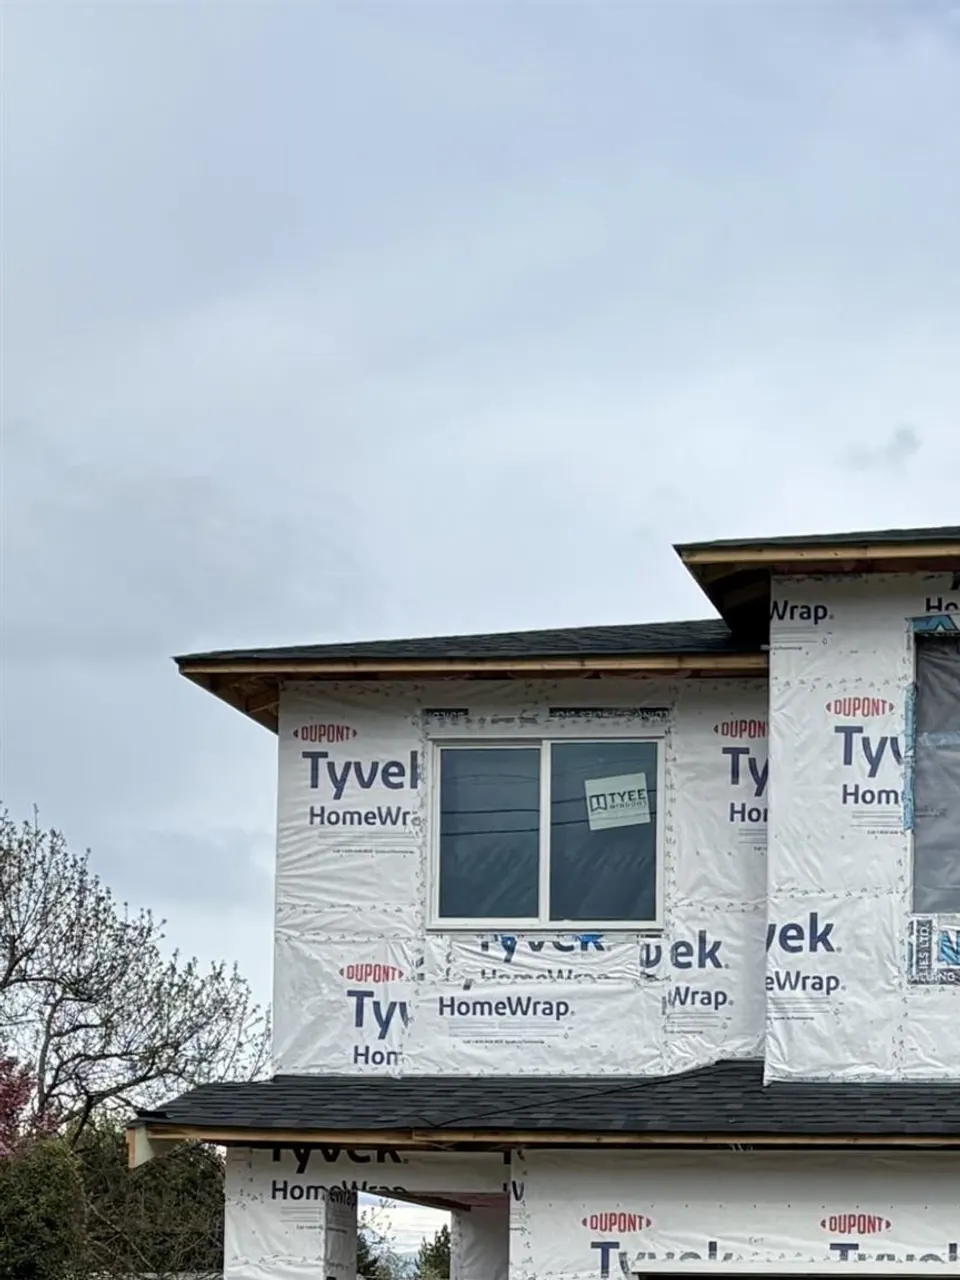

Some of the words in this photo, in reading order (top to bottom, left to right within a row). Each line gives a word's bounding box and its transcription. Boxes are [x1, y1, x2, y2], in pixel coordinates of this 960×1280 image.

[834, 697, 887, 717] DUPONT
[301, 724, 350, 743] DUPONT
[721, 719, 767, 738] DUPON
[608, 788, 646, 803] TYEE
[729, 802, 768, 822] Ho
[346, 964, 397, 983] DUPONT
[439, 996, 569, 1020] HomeWrap
[589, 1212, 645, 1232] DUPONT
[829, 1214, 884, 1234] DUPONT
